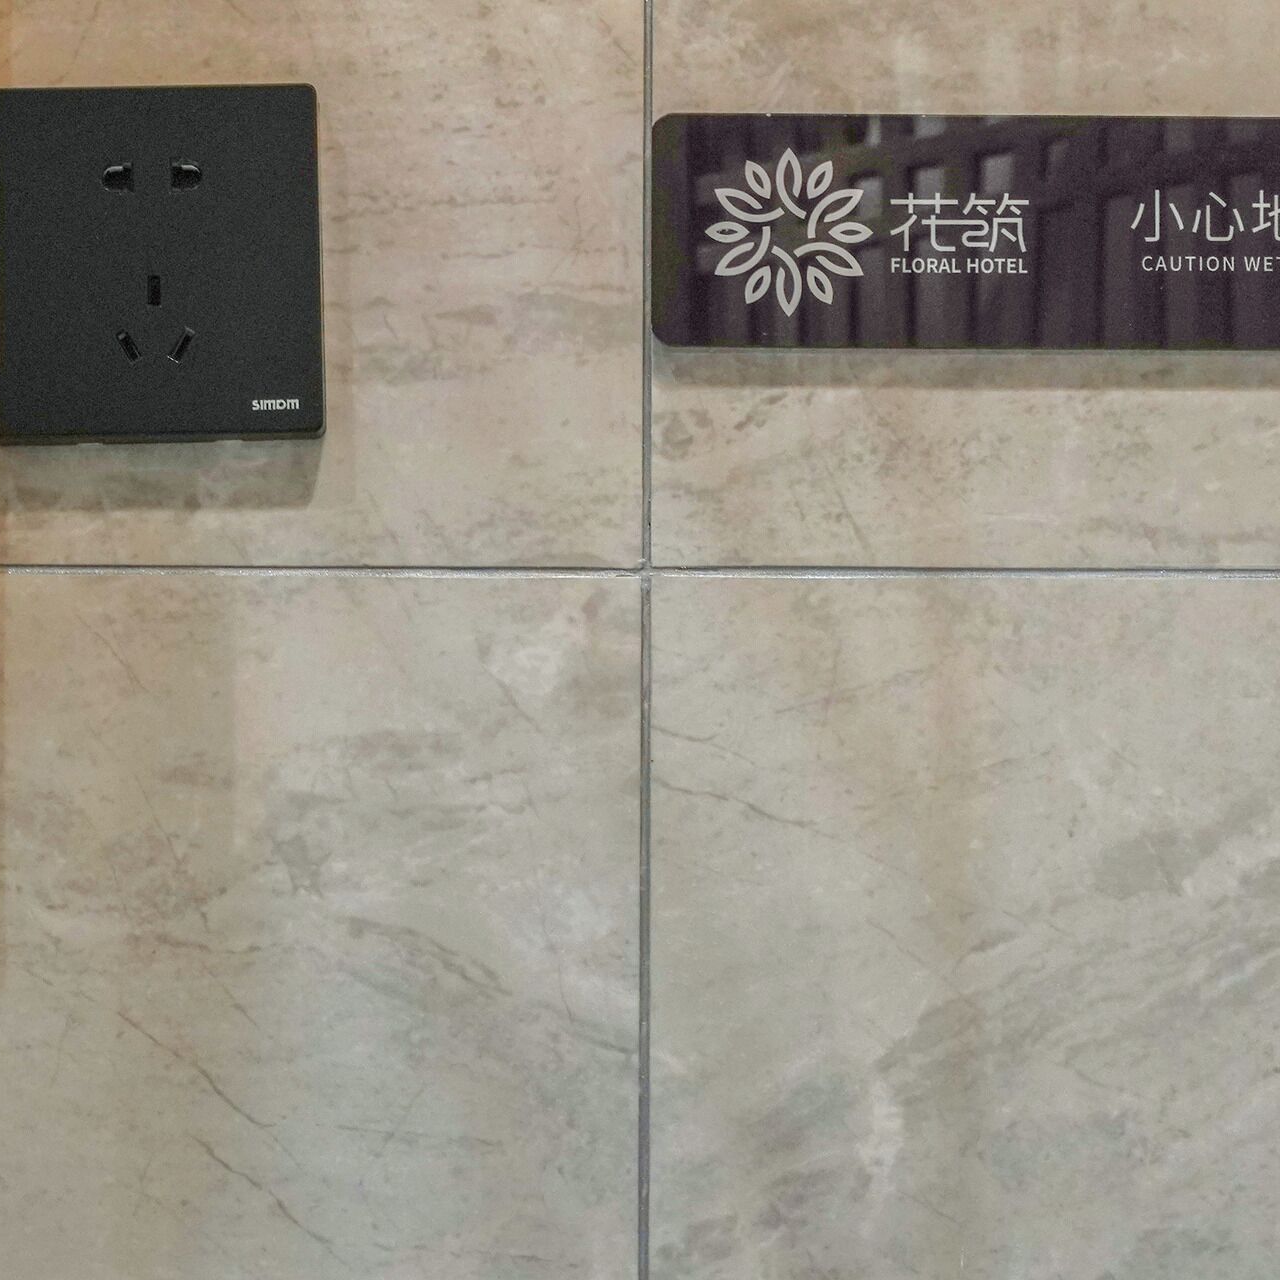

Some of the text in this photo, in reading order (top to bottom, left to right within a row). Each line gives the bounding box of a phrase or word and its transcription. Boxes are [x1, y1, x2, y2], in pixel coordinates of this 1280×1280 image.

[890, 192, 1030, 253] 花筑
[890, 257, 1028, 274] FLORAL HOTEL
[1141, 255, 1235, 272] CAUTION
